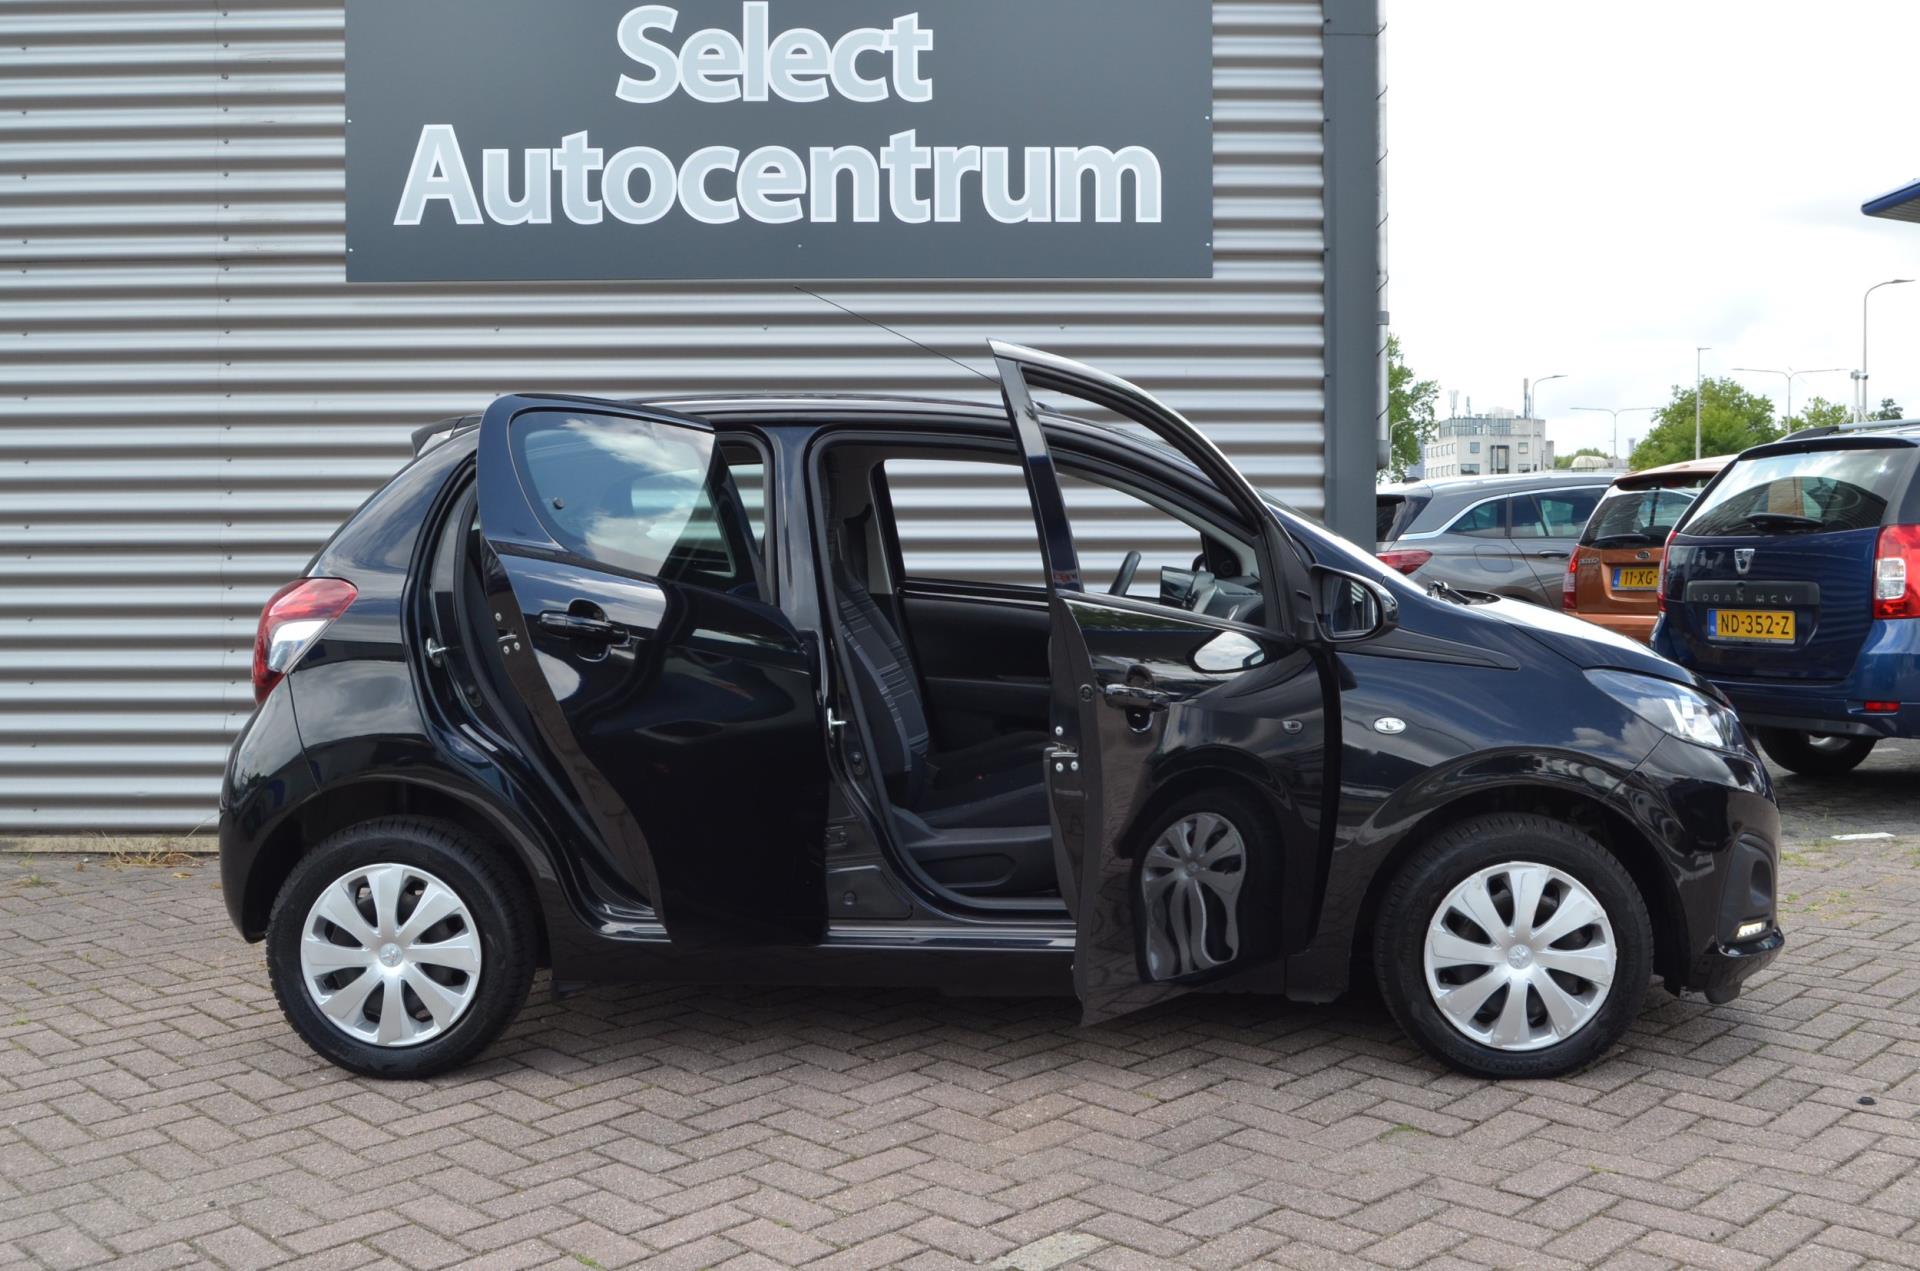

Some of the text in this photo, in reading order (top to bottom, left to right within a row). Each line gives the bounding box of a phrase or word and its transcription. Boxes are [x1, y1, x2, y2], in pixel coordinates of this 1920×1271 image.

[615, 1, 934, 103] Select
[394, 124, 1163, 226] Autocentrum
[1624, 570, 1658, 585] 11-XG-
[1693, 593, 1793, 603] LOGAN MCV
[1720, 613, 1790, 635] ND-352-Z
